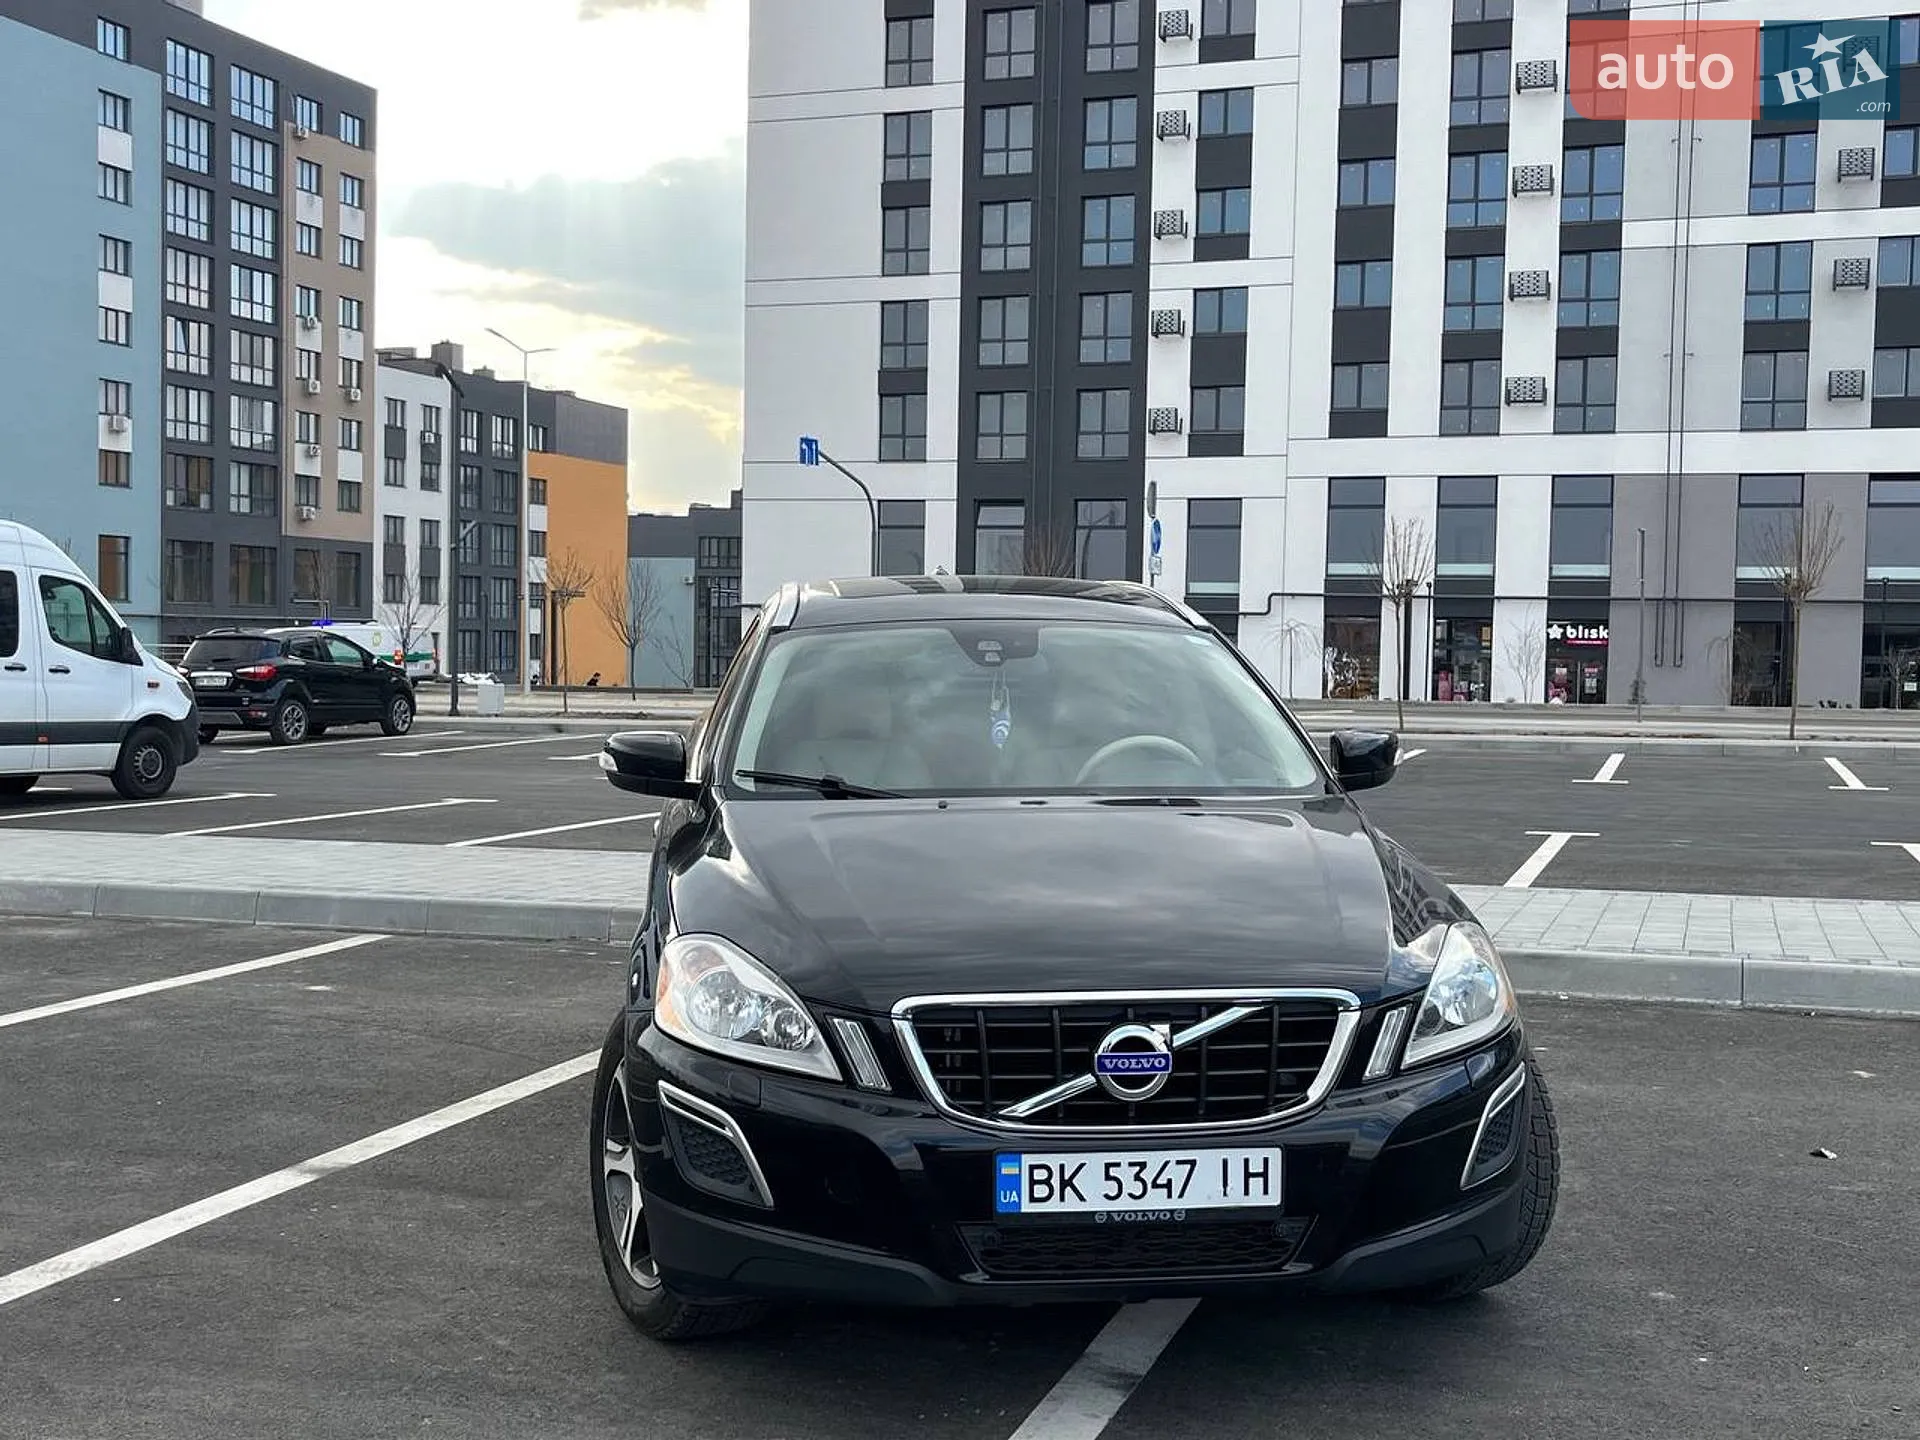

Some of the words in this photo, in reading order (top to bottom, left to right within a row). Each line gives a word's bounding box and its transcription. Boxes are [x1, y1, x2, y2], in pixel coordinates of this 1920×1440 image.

[1566, 624, 1609, 639] blisk
[1102, 1057, 1166, 1070] VOLVO
[1028, 1162, 1087, 1203] BK
[1103, 1159, 1197, 1201] 5347
[1000, 1190, 1020, 1203] UA
[1110, 1211, 1171, 1221] VOLVO
